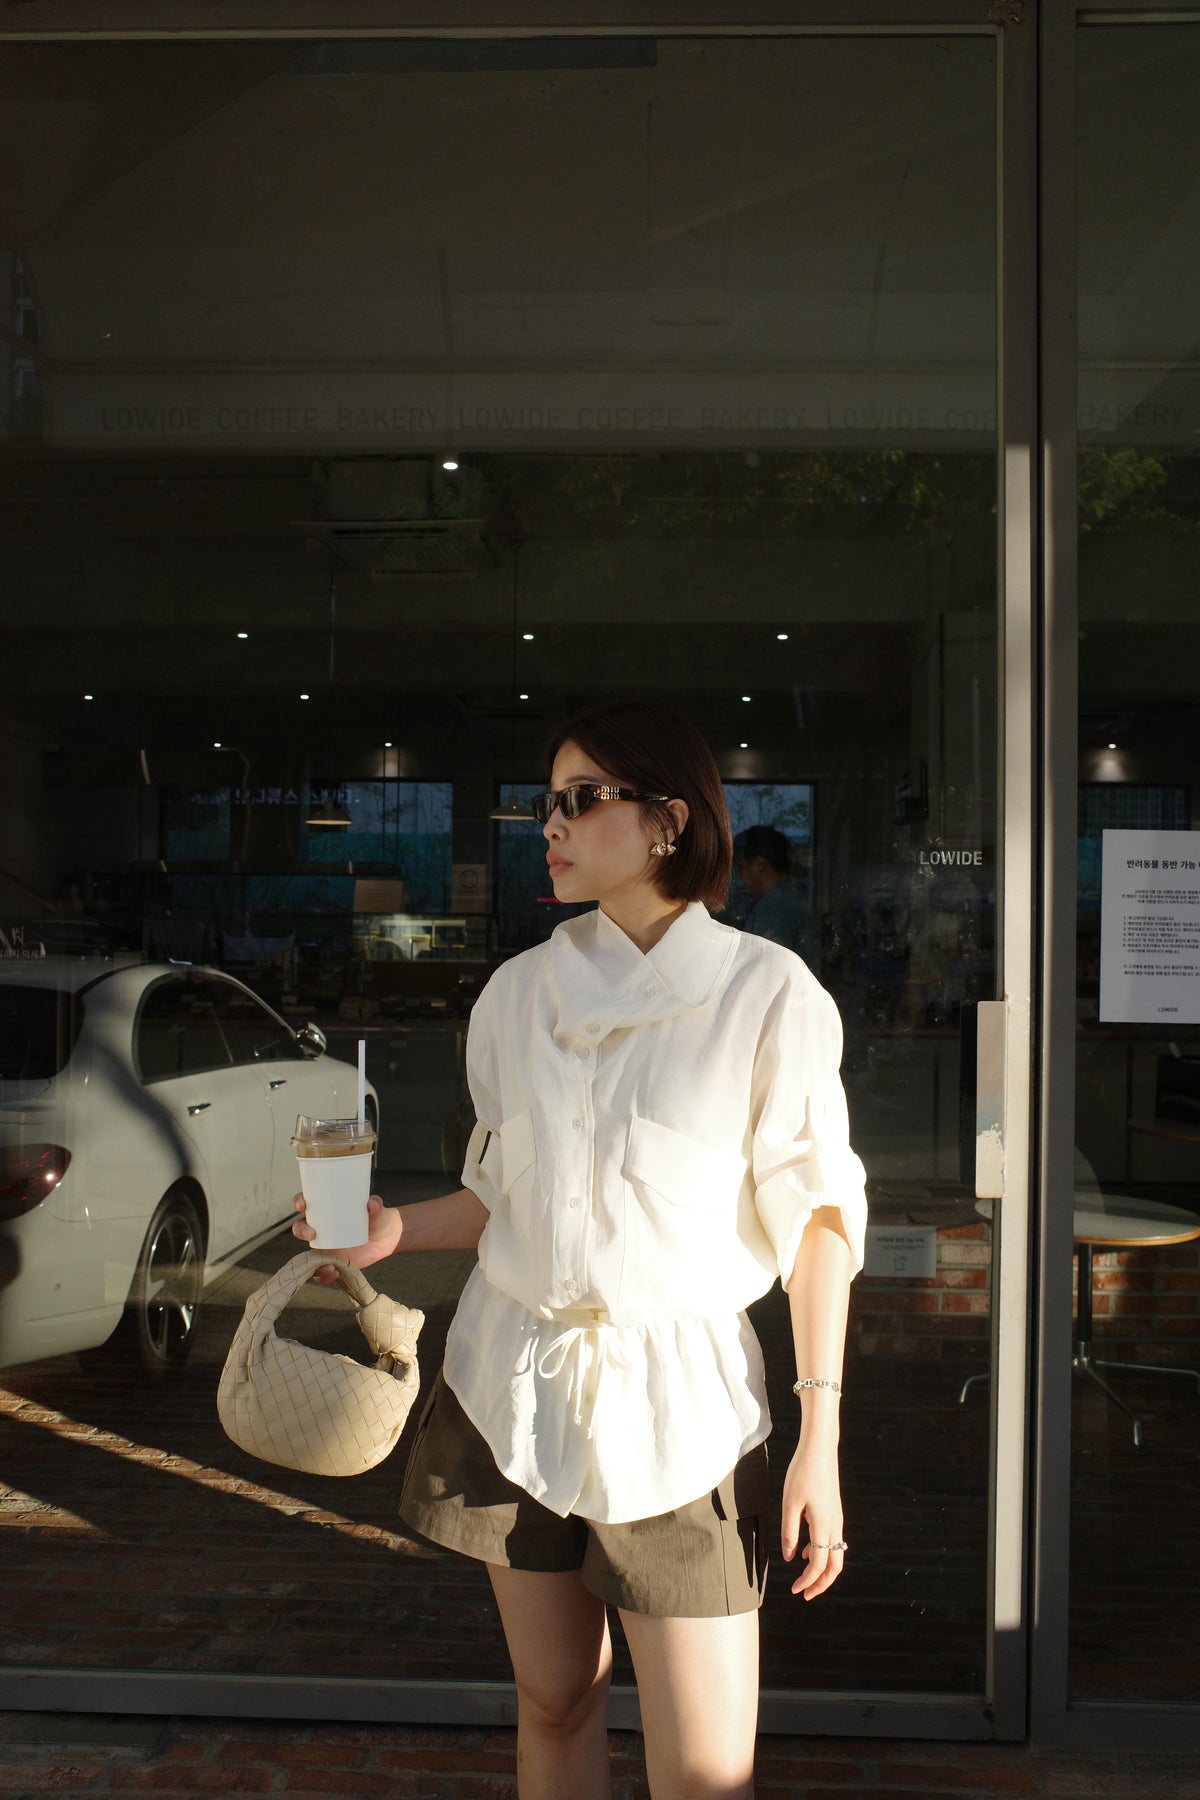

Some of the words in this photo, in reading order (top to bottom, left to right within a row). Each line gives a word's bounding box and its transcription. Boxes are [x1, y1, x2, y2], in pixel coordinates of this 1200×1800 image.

[102, 407, 203, 431] LOWIDE
[216, 407, 319, 431] COFFEE
[336, 407, 442, 431] BAKERY
[458, 407, 561, 430] LOWIDE
[577, 407, 682, 430] COFFEE
[700, 407, 807, 430] BAKERY
[825, 407, 930, 430] LOWIDE
[1081, 404, 1186, 428] BAKERY
[919, 850, 983, 866] LOWIDE
[1126, 859, 1159, 869] 반려동물
[1161, 860, 1178, 869] 동반
[1180, 860, 1196, 870] 가능
